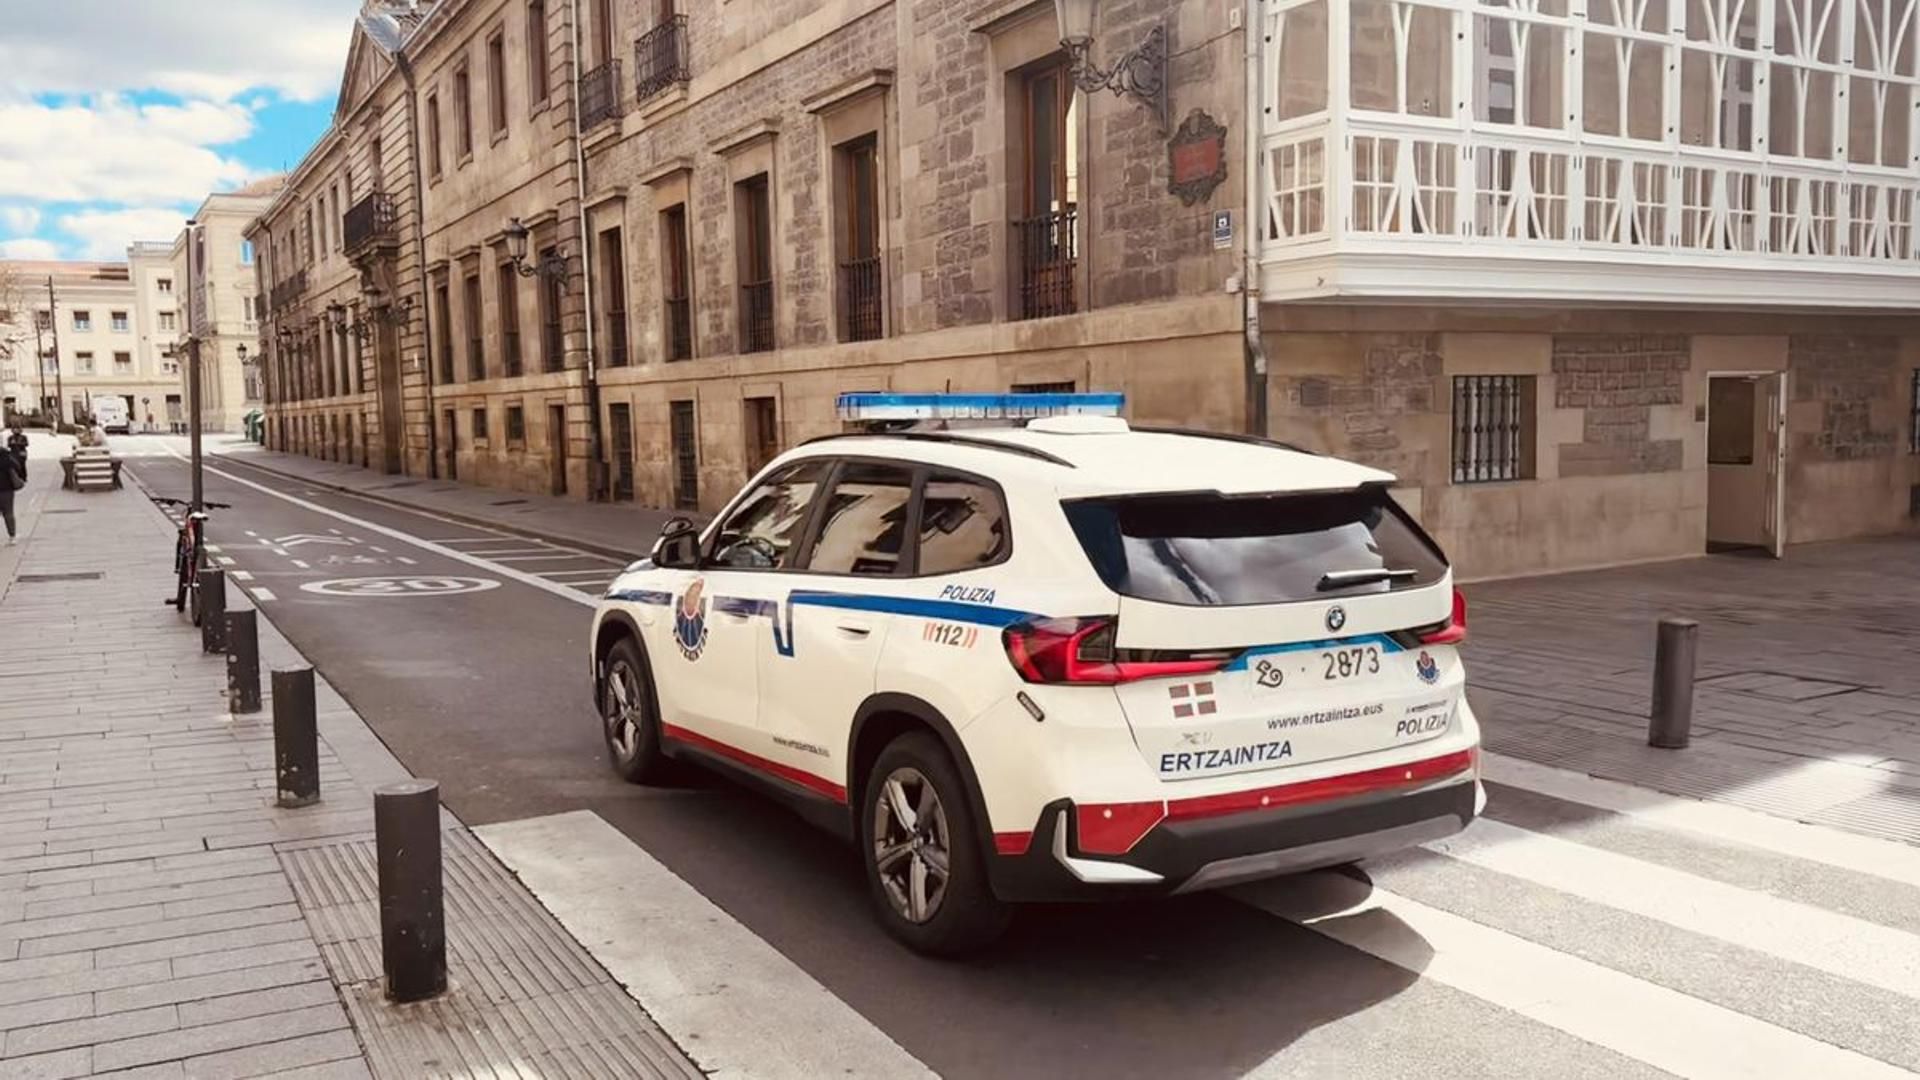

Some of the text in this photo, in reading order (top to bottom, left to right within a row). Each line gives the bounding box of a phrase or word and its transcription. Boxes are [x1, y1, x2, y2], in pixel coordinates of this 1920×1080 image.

[940, 584, 996, 604] POLIZIA
[1322, 646, 1380, 680] 2873
[1267, 703, 1383, 729] www.ertzaintza.eus
[1395, 711, 1448, 737] POLIZIA
[1160, 740, 1292, 772] ERTZAINTZA
